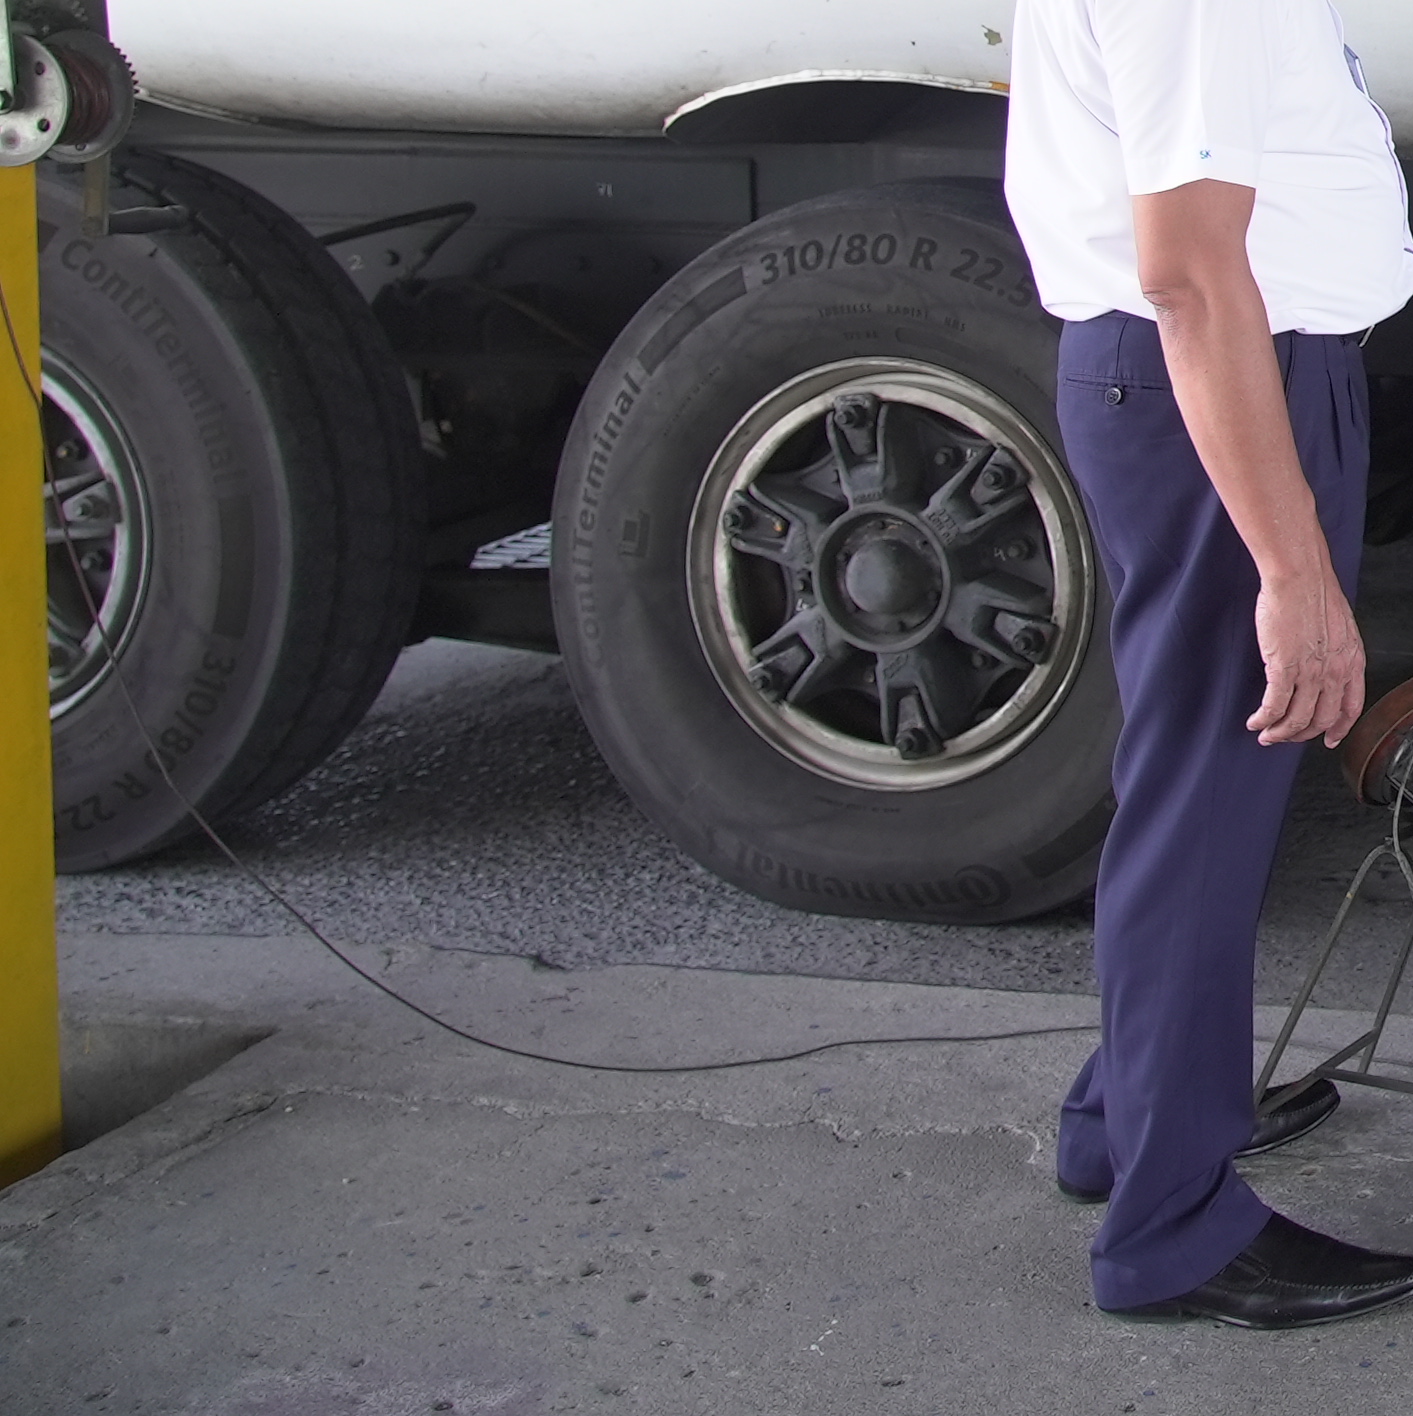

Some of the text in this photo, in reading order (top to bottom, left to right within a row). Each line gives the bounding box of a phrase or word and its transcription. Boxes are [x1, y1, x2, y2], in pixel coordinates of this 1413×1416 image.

[759, 233, 898, 286] 310/80
[908, 236, 939, 272] R
[60, 792, 117, 832] 22
